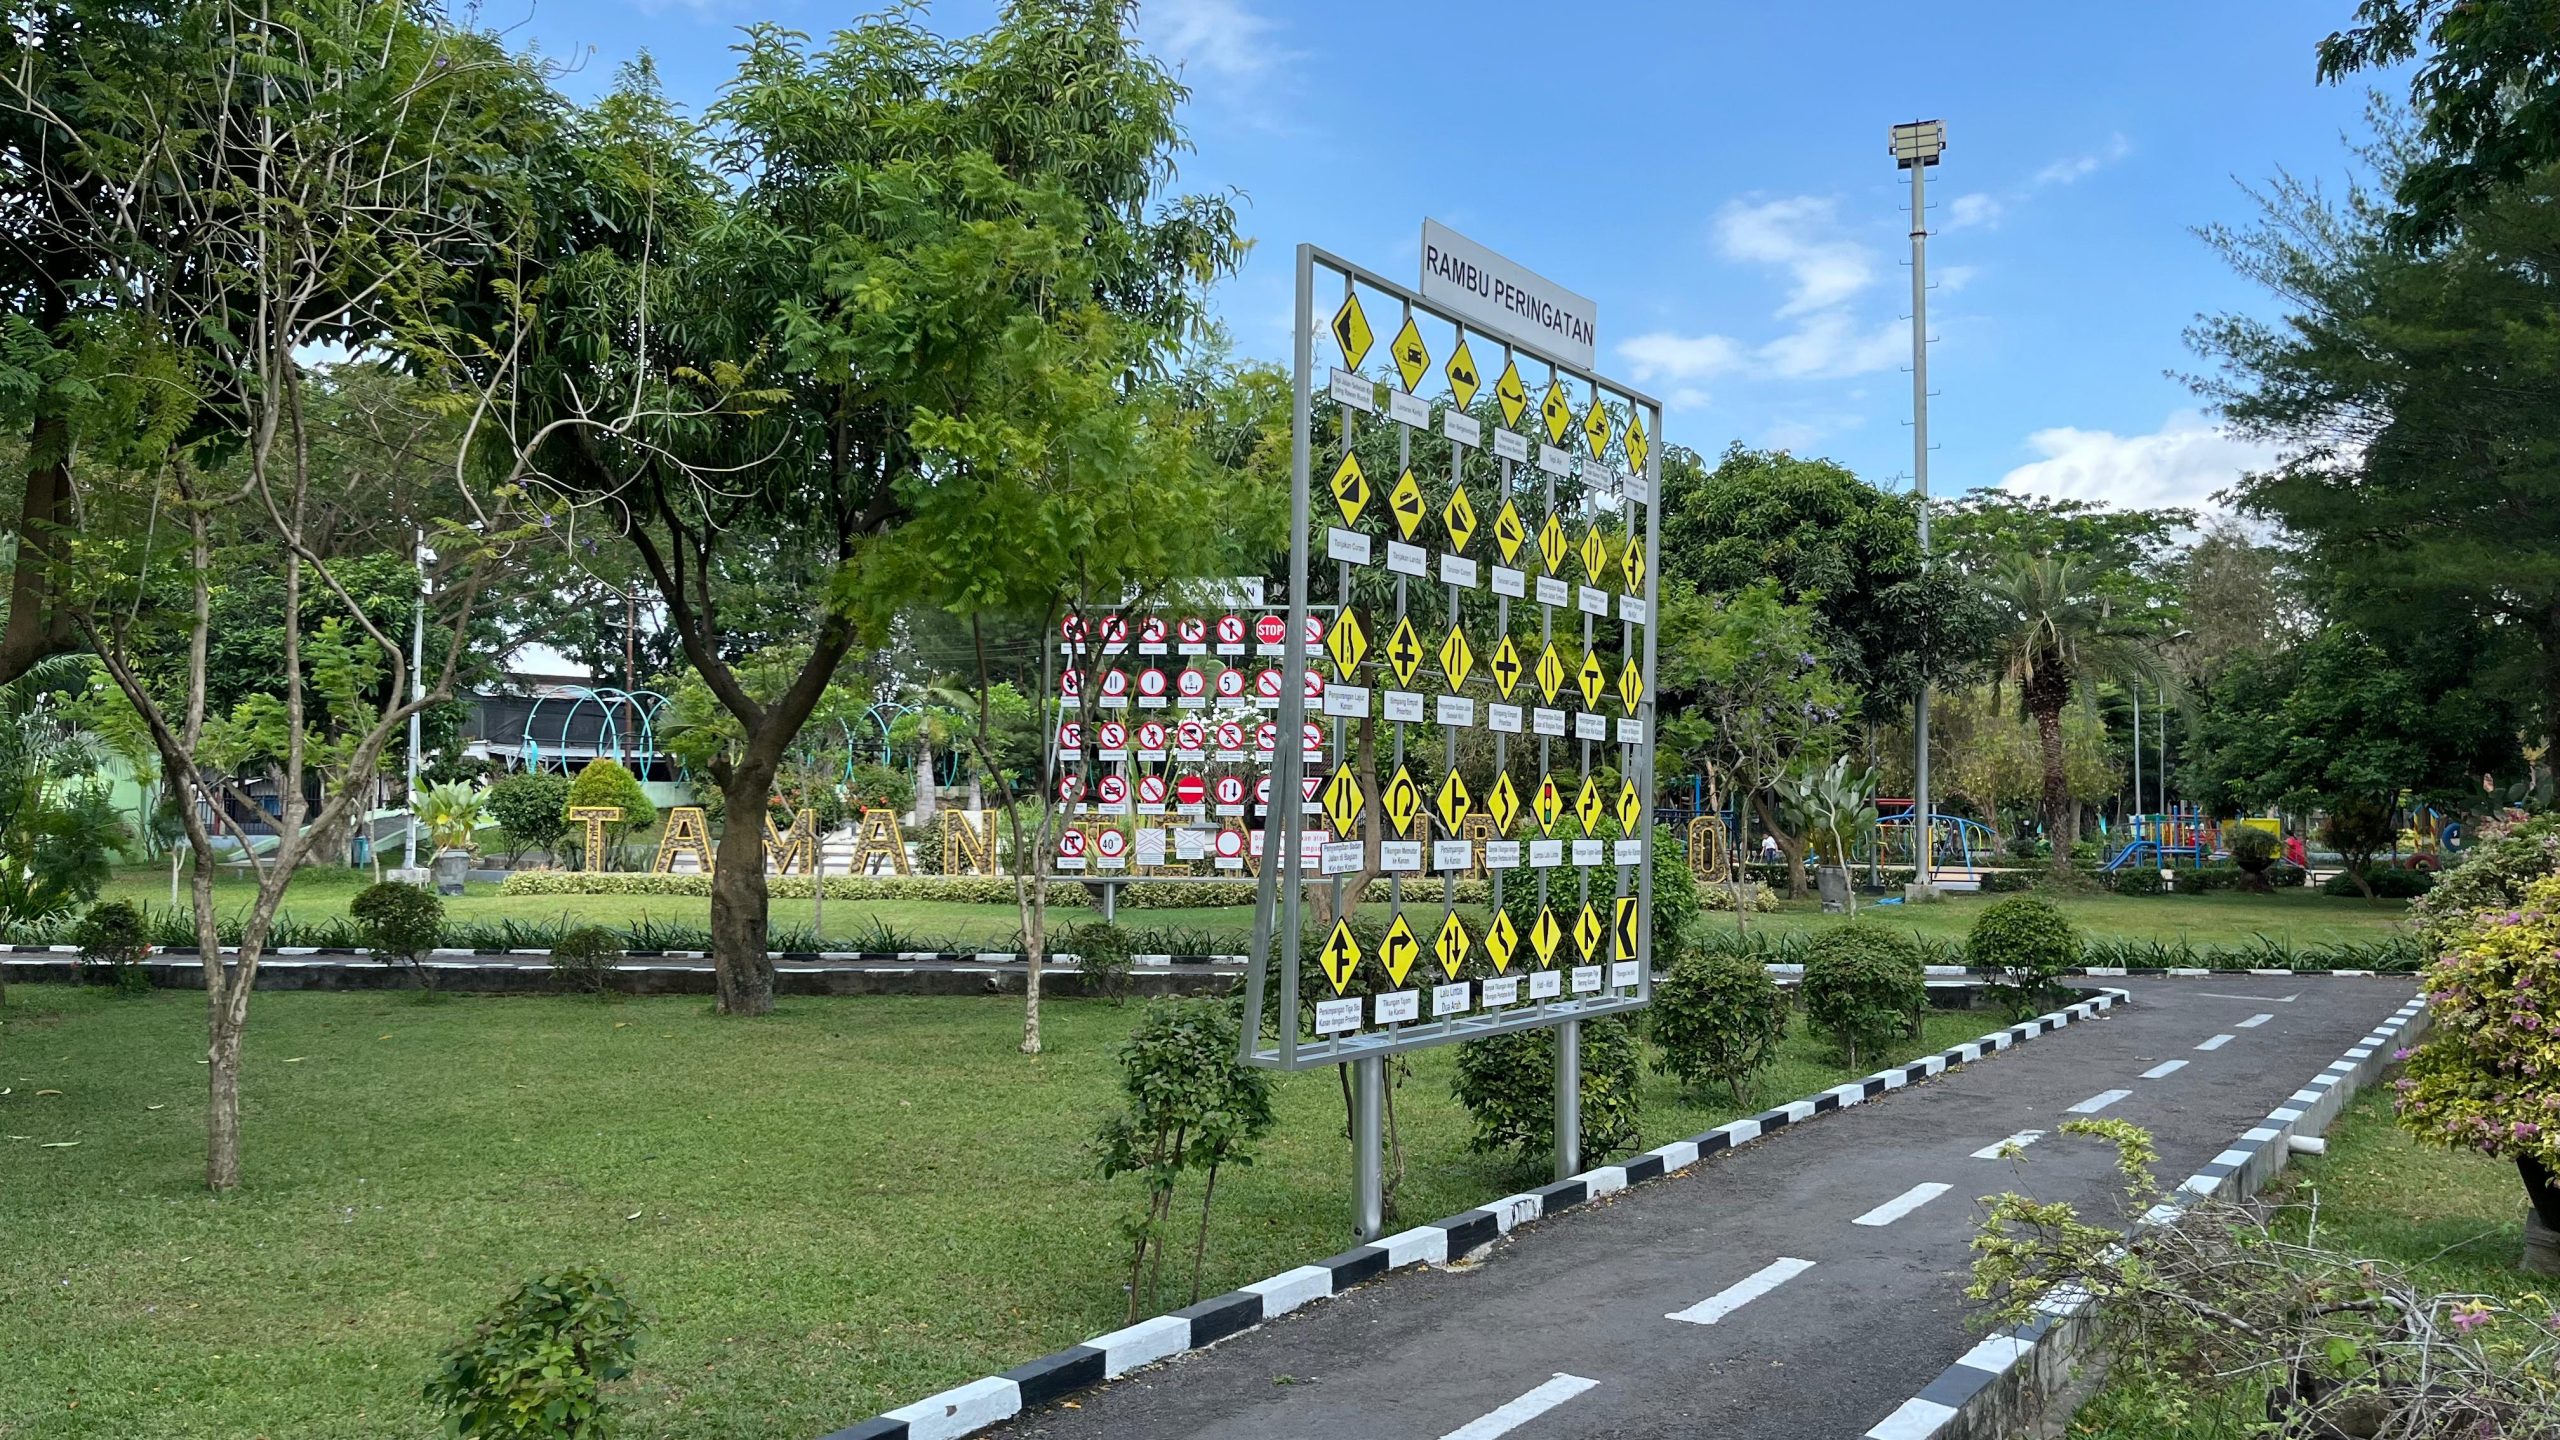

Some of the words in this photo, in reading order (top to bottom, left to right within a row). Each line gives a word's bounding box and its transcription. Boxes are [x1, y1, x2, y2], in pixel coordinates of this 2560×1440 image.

[1426, 244, 1489, 299] RAMBU
[1494, 277, 1594, 347] PERINGATAN
[1258, 624, 1284, 636] STOP
[1223, 676, 1231, 692] 5
[1107, 727, 1118, 744] S
[569, 806, 1000, 876] TAMAN
[1102, 838, 1114, 850] 40
[1439, 987, 1449, 998] Lalu
[1441, 1001, 1450, 1012] Dua
[1450, 999, 1461, 1010] Arah
